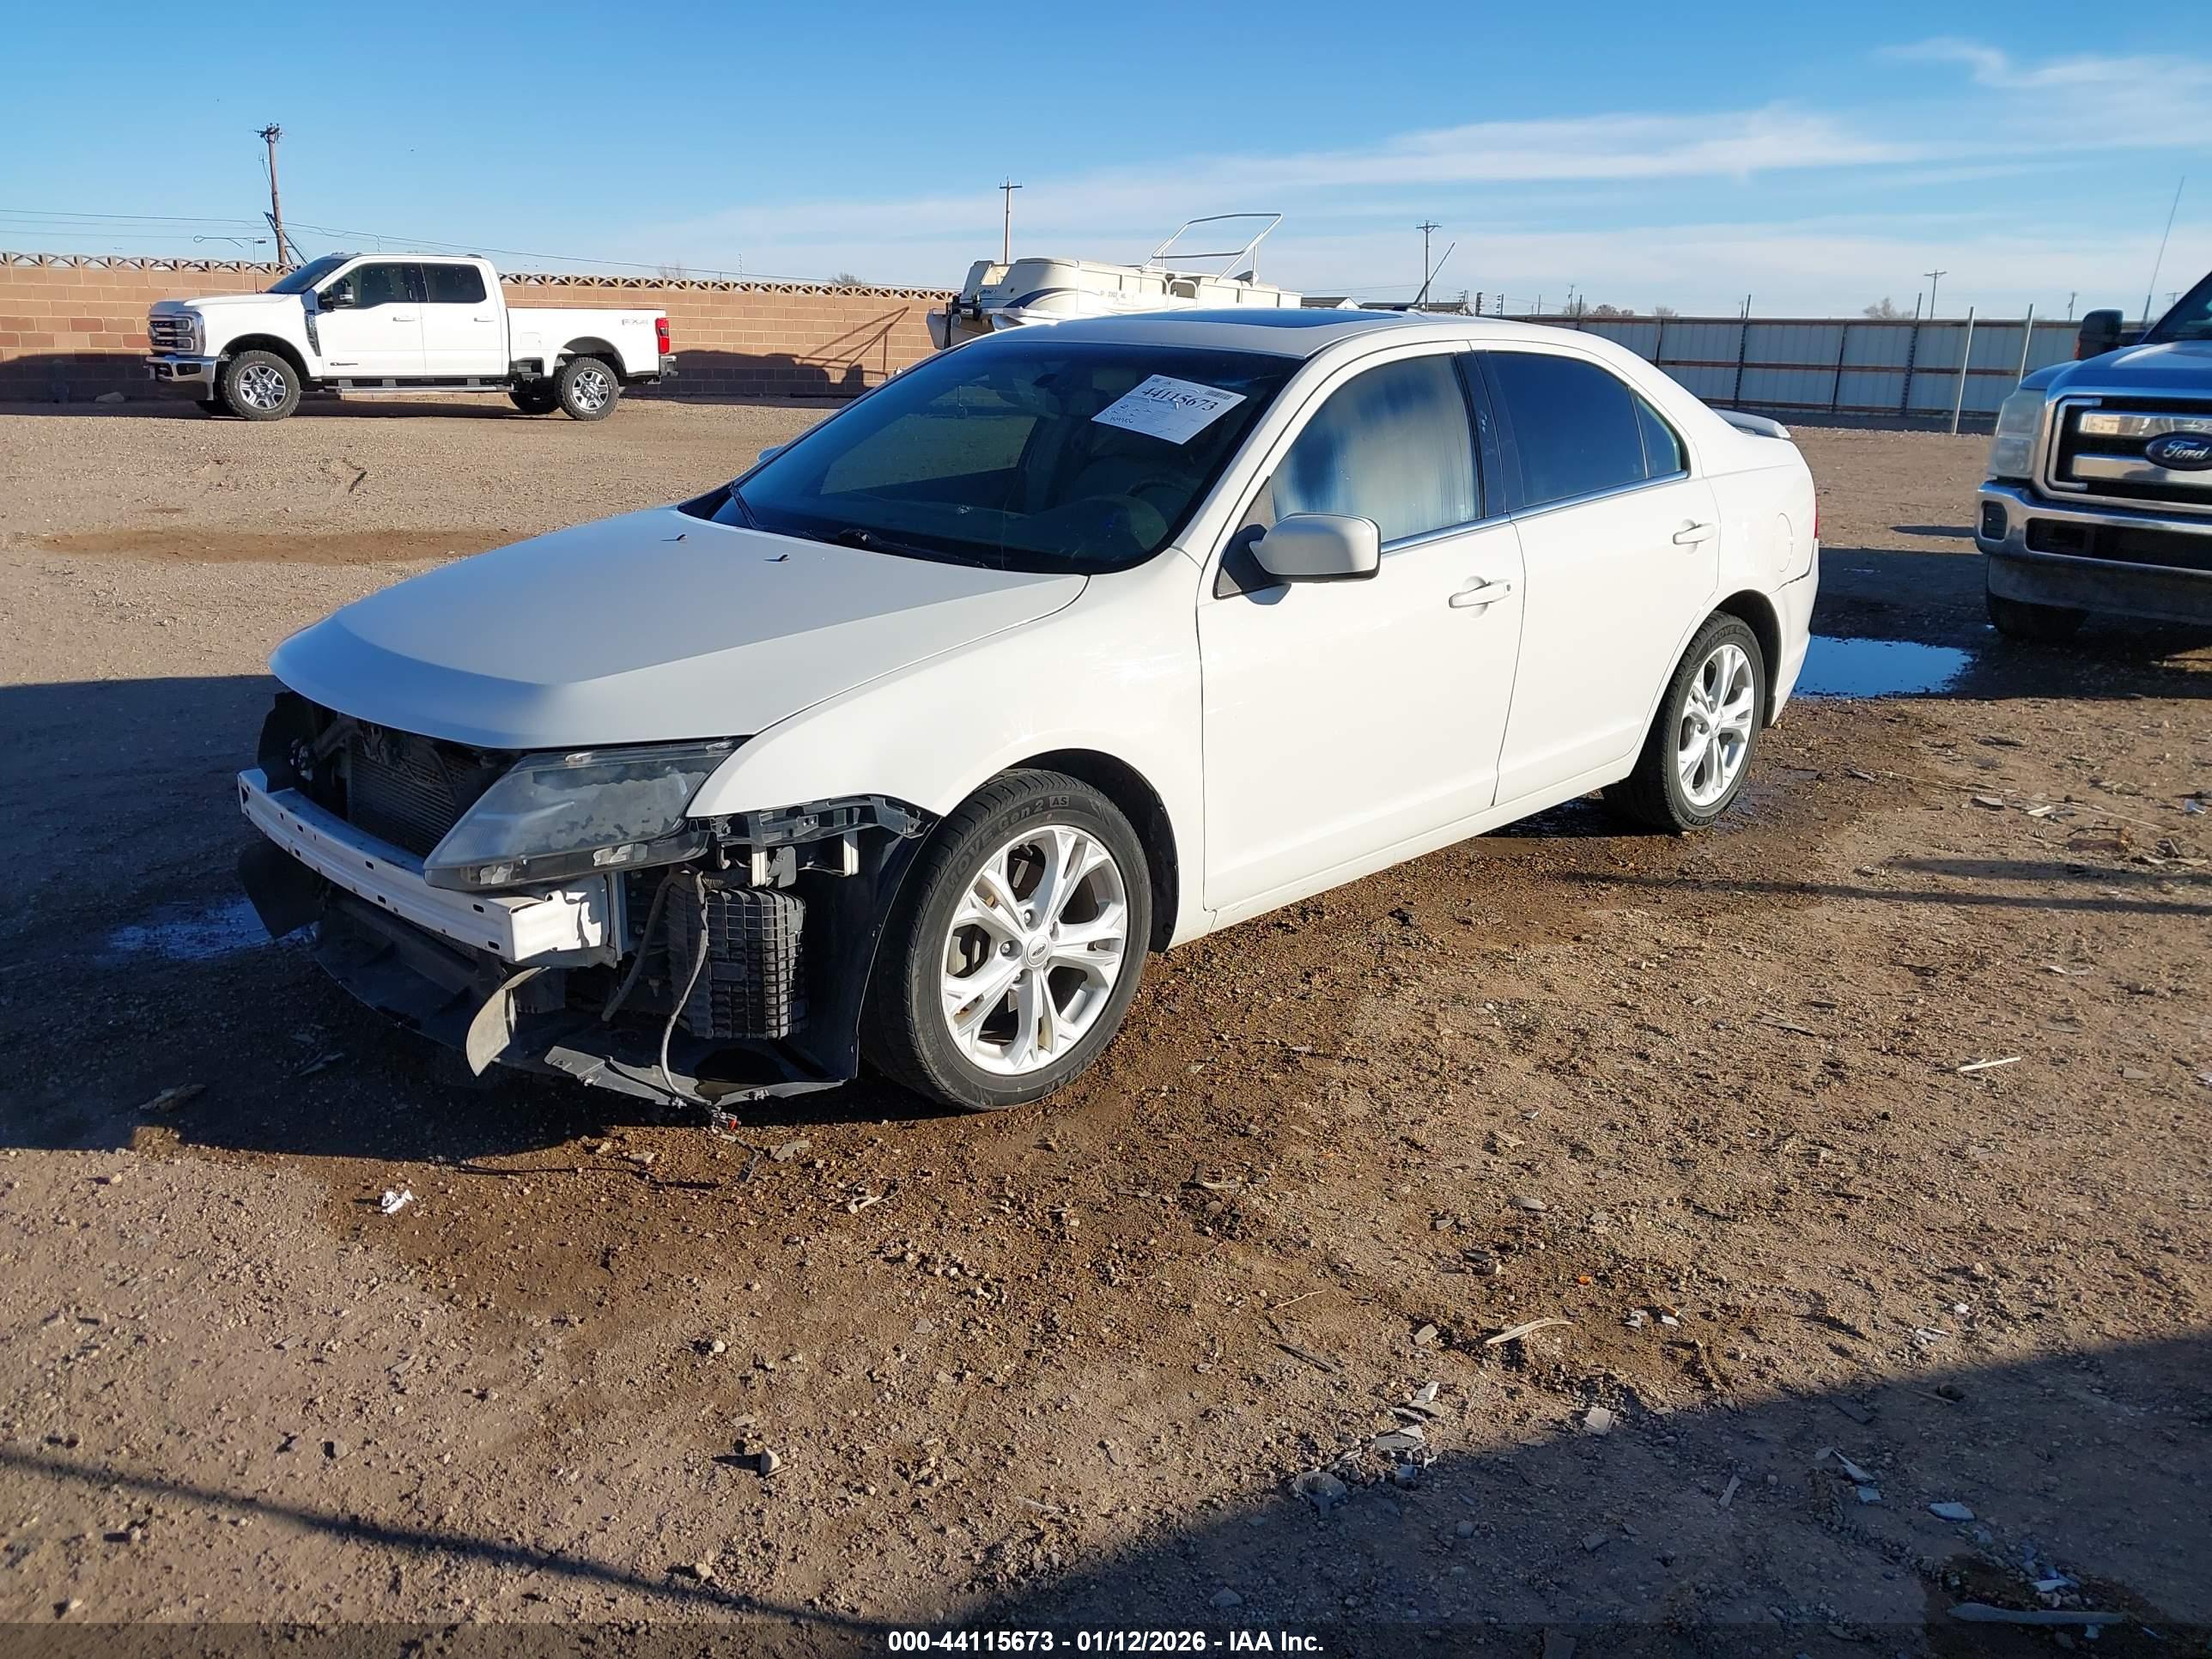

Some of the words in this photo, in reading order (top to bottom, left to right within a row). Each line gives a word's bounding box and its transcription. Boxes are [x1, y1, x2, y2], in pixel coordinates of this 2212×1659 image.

[1142, 387, 1219, 411] 44115673
[2163, 440, 2210, 459] Ford
[997, 806, 1030, 831] Gen
[1034, 799, 1044, 812] 2
[1051, 796, 1068, 806] AS
